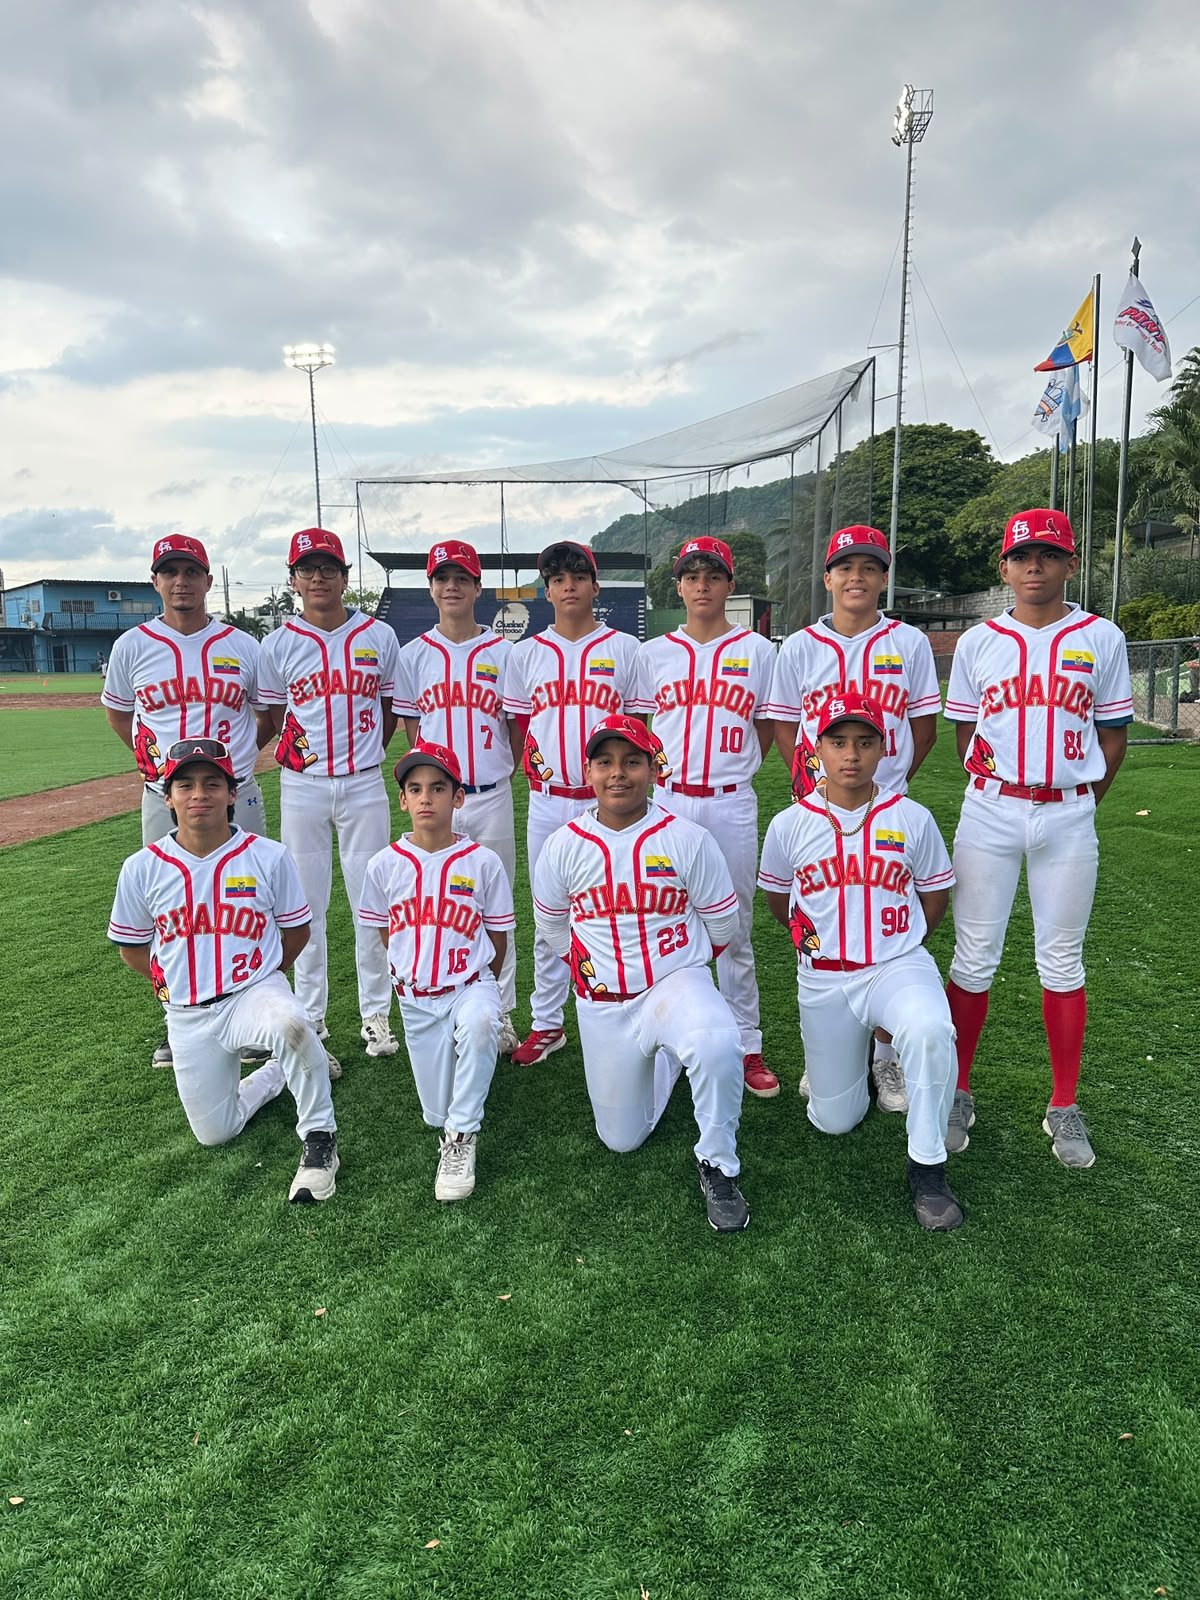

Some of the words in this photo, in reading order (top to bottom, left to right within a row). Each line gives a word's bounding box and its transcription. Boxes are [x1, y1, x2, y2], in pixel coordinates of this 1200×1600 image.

[136, 676, 246, 713] ECUADOR
[289, 669, 379, 706] ECUADOR
[655, 678, 756, 721] ECUADOR
[982, 674, 1095, 724] ECUADOR
[218, 720, 231, 743] 2
[480, 725, 493, 749] 7
[720, 726, 744, 753] 10
[884, 728, 897, 757] 1
[1064, 729, 1085, 760] 81
[795, 854, 914, 898] ECUADOR
[388, 896, 482, 941] ECUADOR
[571, 881, 689, 922] ECUADOR
[881, 904, 910, 937] 90
[657, 922, 689, 957] 23
[232, 946, 262, 983] 24
[447, 948, 471, 975] 16
